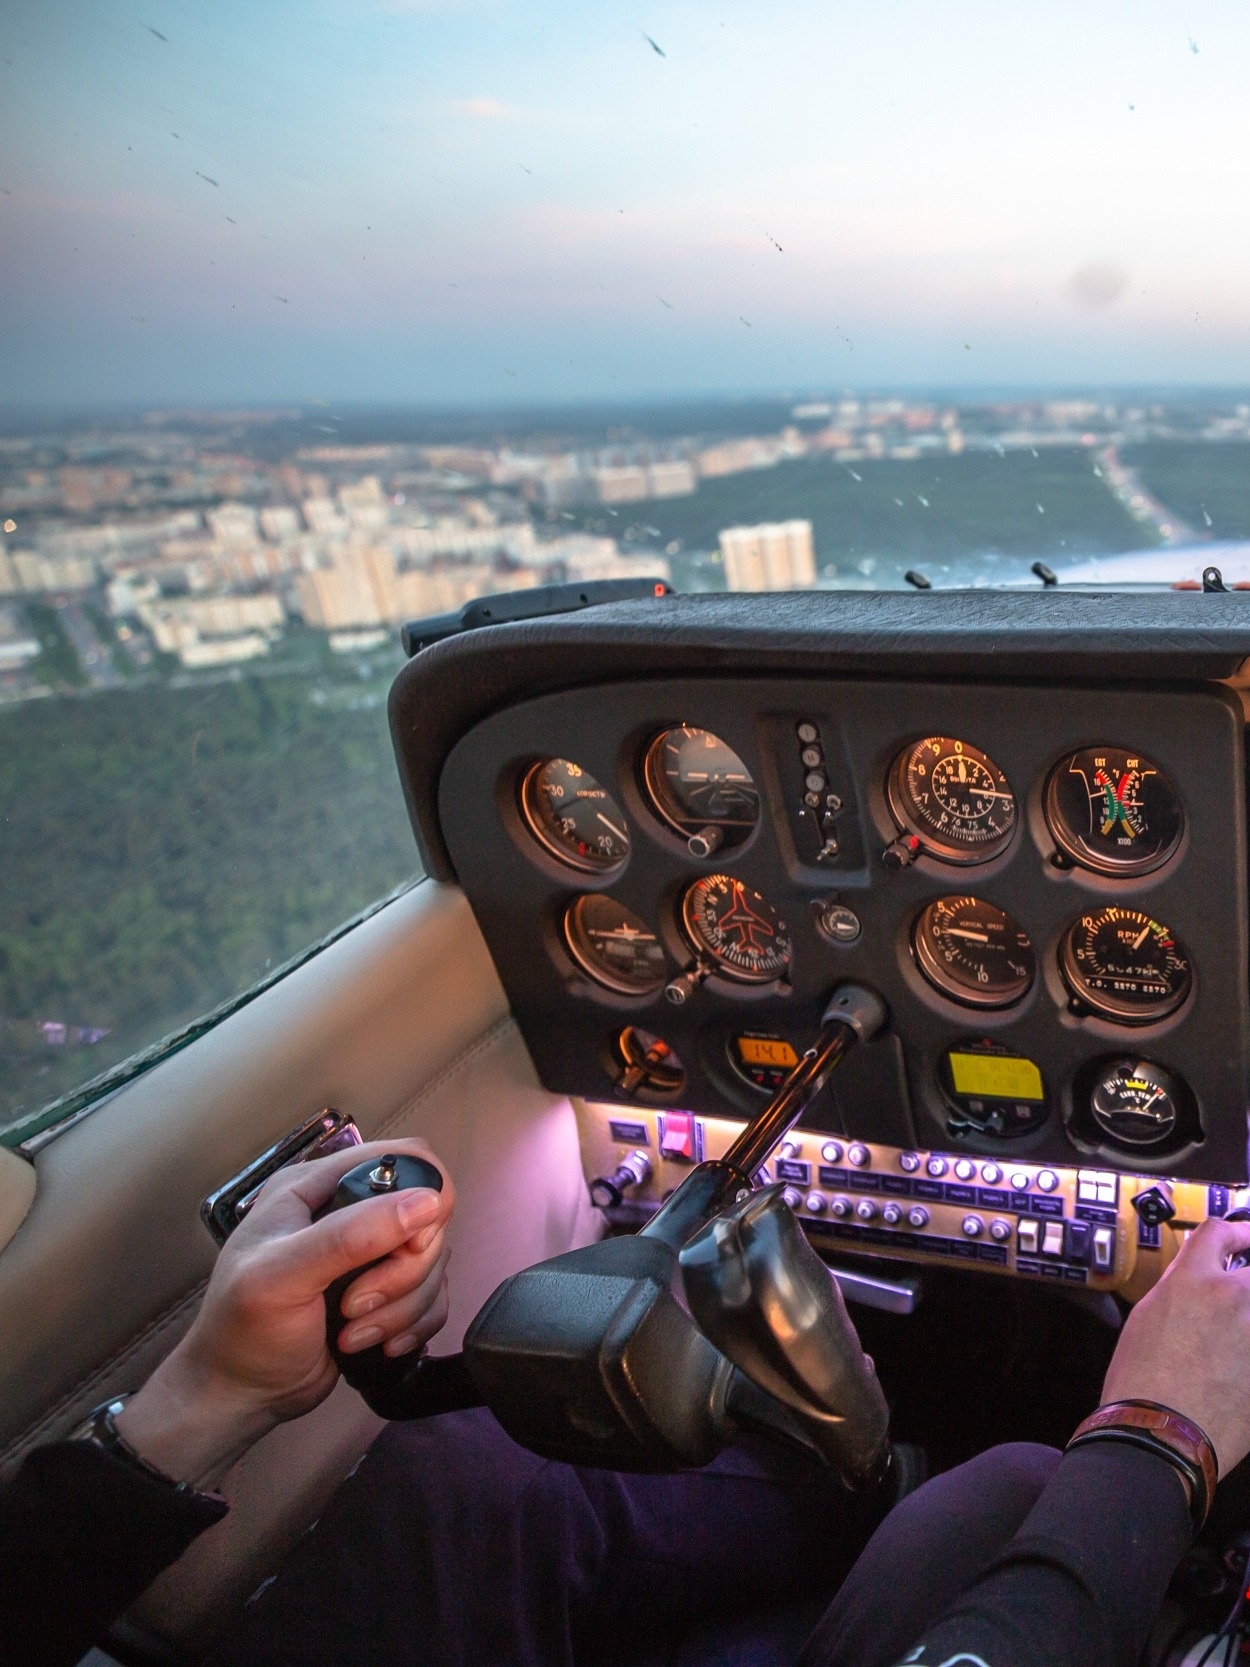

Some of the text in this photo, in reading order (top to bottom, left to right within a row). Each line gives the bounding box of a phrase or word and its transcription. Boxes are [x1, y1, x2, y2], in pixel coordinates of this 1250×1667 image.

[932, 743, 941, 757] 9
[954, 740, 963, 754] 0
[1094, 758, 1139, 768] EGT CHT
[566, 762, 582, 777] 35
[918, 764, 926, 776] 8
[972, 768, 979, 778] 2
[939, 775, 947, 784] 16
[982, 779, 989, 788] 4
[549, 784, 564, 797] 30
[939, 786, 948, 796] 14
[921, 793, 929, 804] 7
[949, 798, 957, 808] 12
[961, 803, 970, 813] 10
[976, 800, 983, 809] 8
[1002, 800, 1010, 812] 3
[940, 811, 948, 823] 6
[598, 835, 613, 848] 20
[986, 922, 1005, 931] SPEED
[1082, 917, 1093, 928] 10
[932, 925, 941, 937] 0
[1117, 930, 1139, 940] RPM
[1077, 948, 1085, 960] 5
[977, 972, 989, 983] 10
